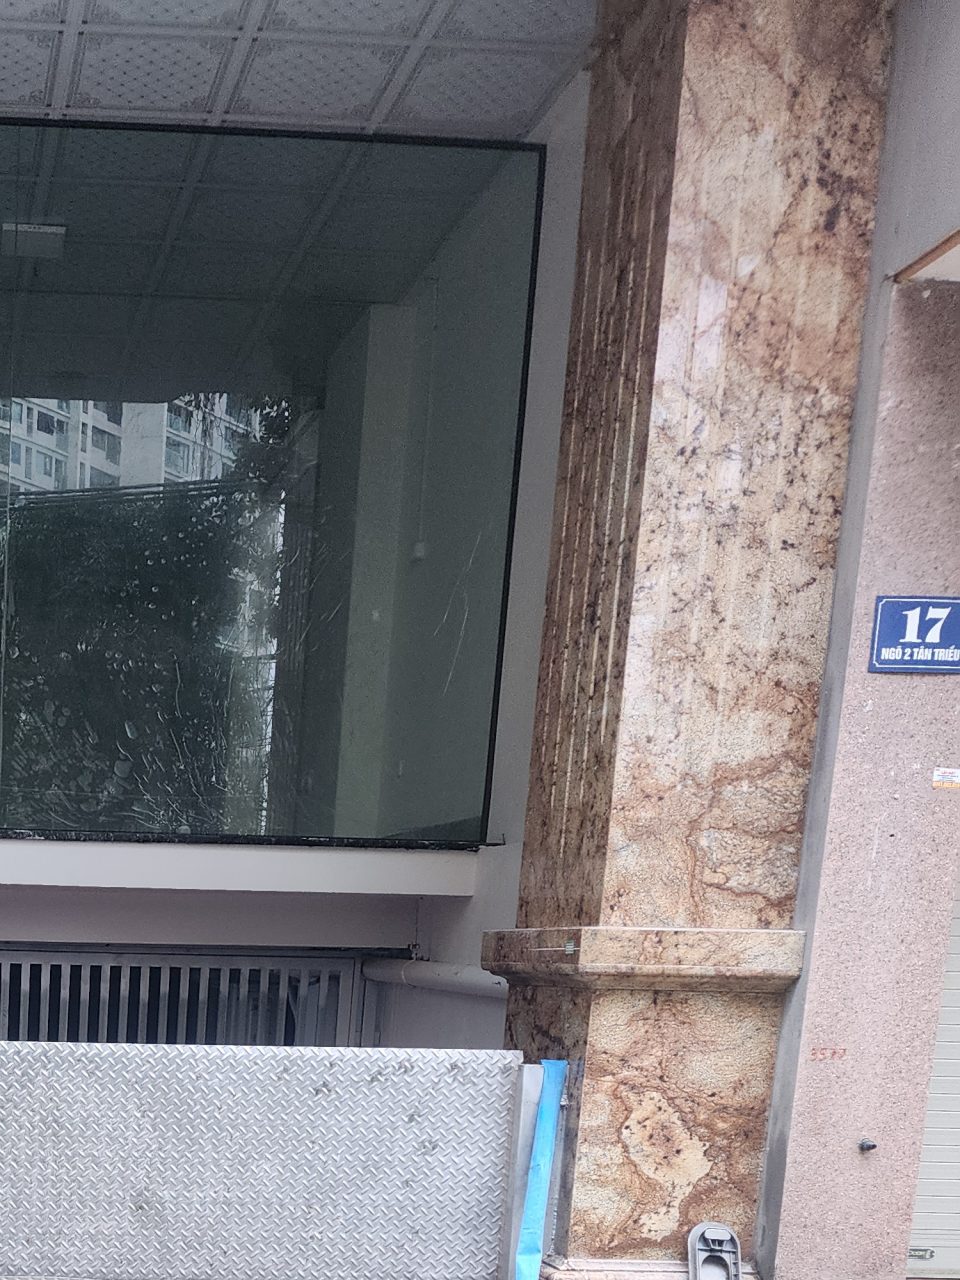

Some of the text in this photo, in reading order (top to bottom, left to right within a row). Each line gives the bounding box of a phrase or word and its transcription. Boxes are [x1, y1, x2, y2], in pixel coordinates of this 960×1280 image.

[899, 606, 952, 643] 17
[880, 645, 902, 660] NGÕ
[903, 648, 911, 660] 2
[912, 645, 933, 660] TÂN
